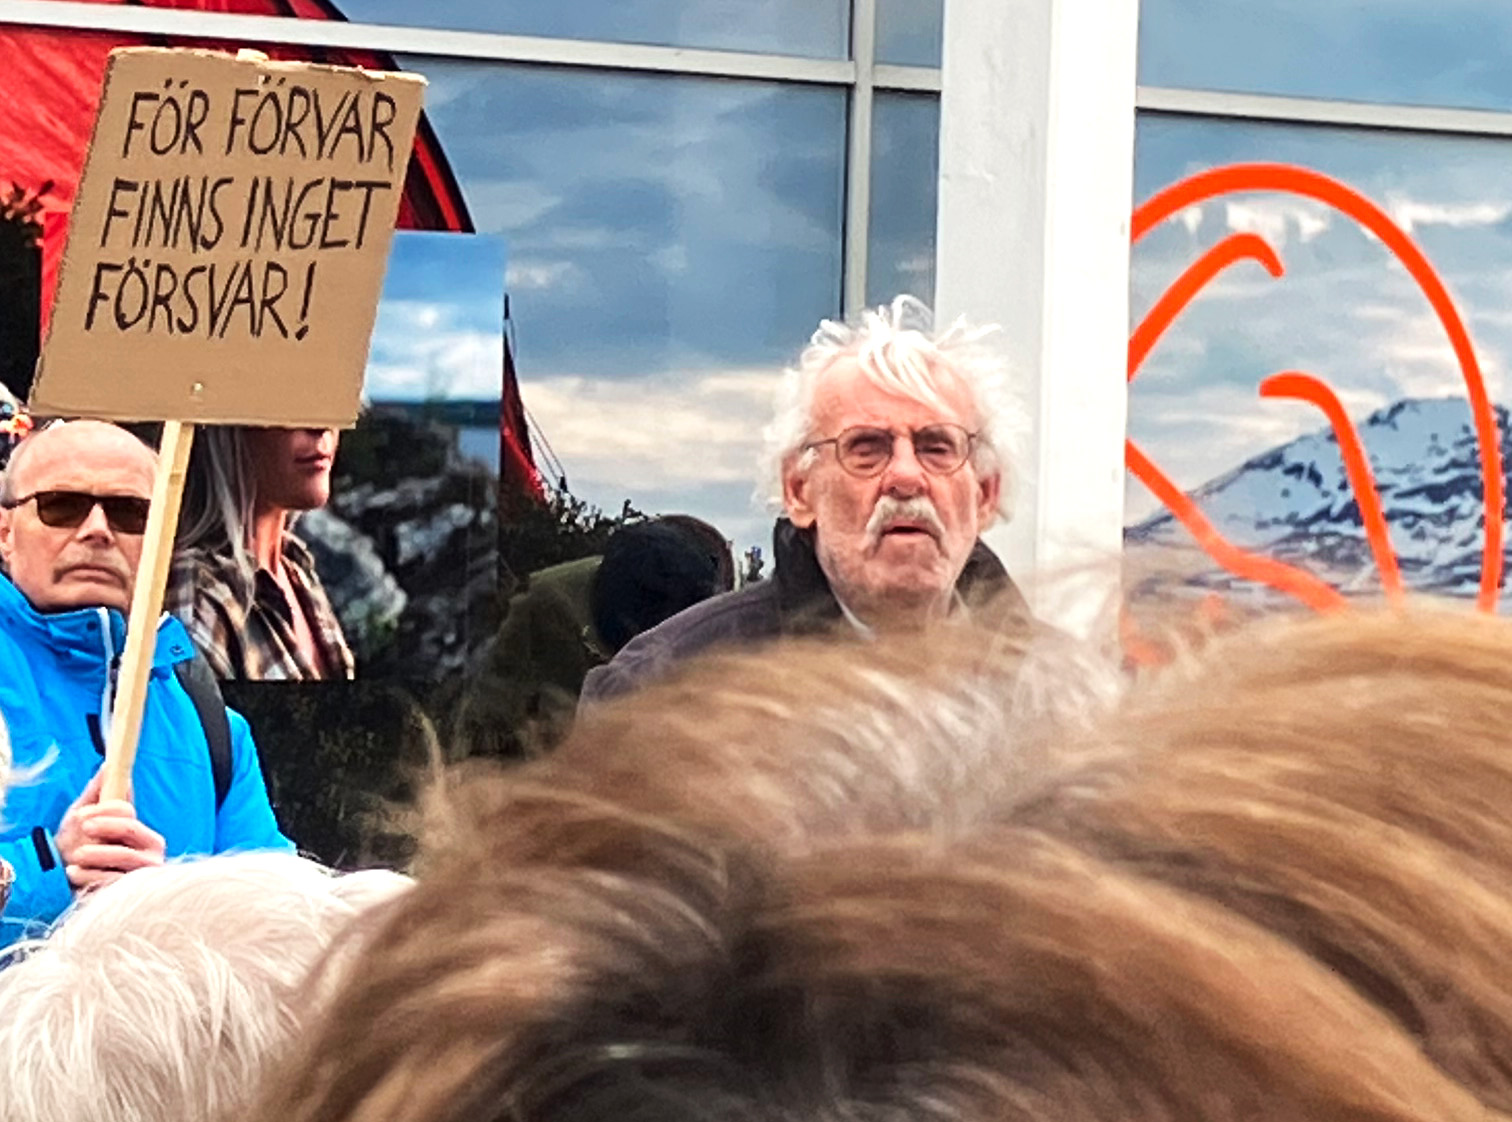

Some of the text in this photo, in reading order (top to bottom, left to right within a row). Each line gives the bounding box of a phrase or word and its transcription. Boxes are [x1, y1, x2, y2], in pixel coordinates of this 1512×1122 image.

[123, 75, 397, 173] FÖR FÖRVAR
[100, 176, 393, 254] FINNS INGET
[84, 256, 318, 341] FÖRSVAR!
